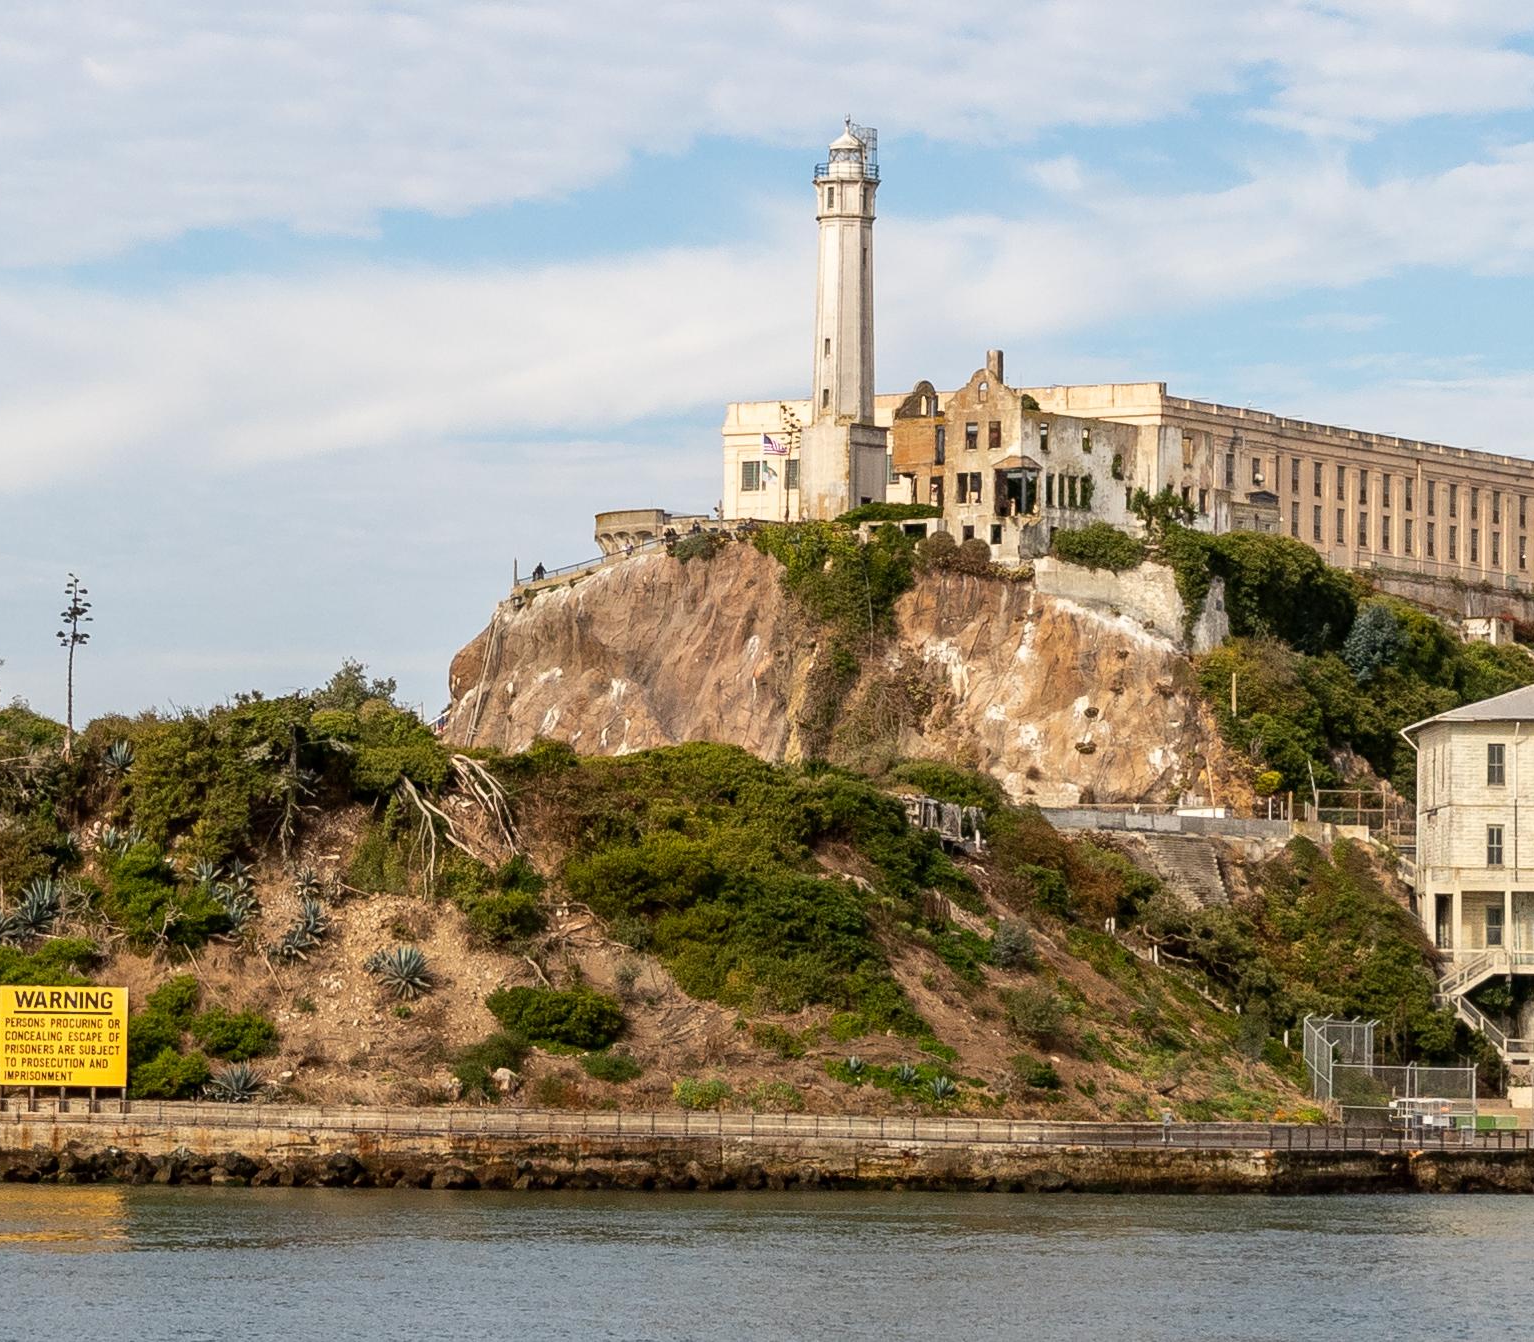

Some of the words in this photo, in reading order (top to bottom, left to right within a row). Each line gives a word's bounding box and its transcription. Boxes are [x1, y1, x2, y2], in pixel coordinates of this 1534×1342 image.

[14, 990, 113, 1010] WARNING
[5, 1018, 45, 1028] PERSONS
[50, 1018, 103, 1028] PROCURING
[108, 1019, 120, 1029] OR
[5, 1031, 62, 1041] CONCEALING
[68, 1032, 102, 1042] ESCAPE
[108, 1032, 120, 1042] OF
[5, 1044, 54, 1054] PRISONERS
[58, 1045, 76, 1055] ARE
[79, 1046, 120, 1056] SUBJECT
[5, 1057, 16, 1068] TO
[21, 1058, 85, 1068] PROSECUTION
[89, 1059, 109, 1069] AND
[4, 1070, 74, 1081] IMPRISONMENT
